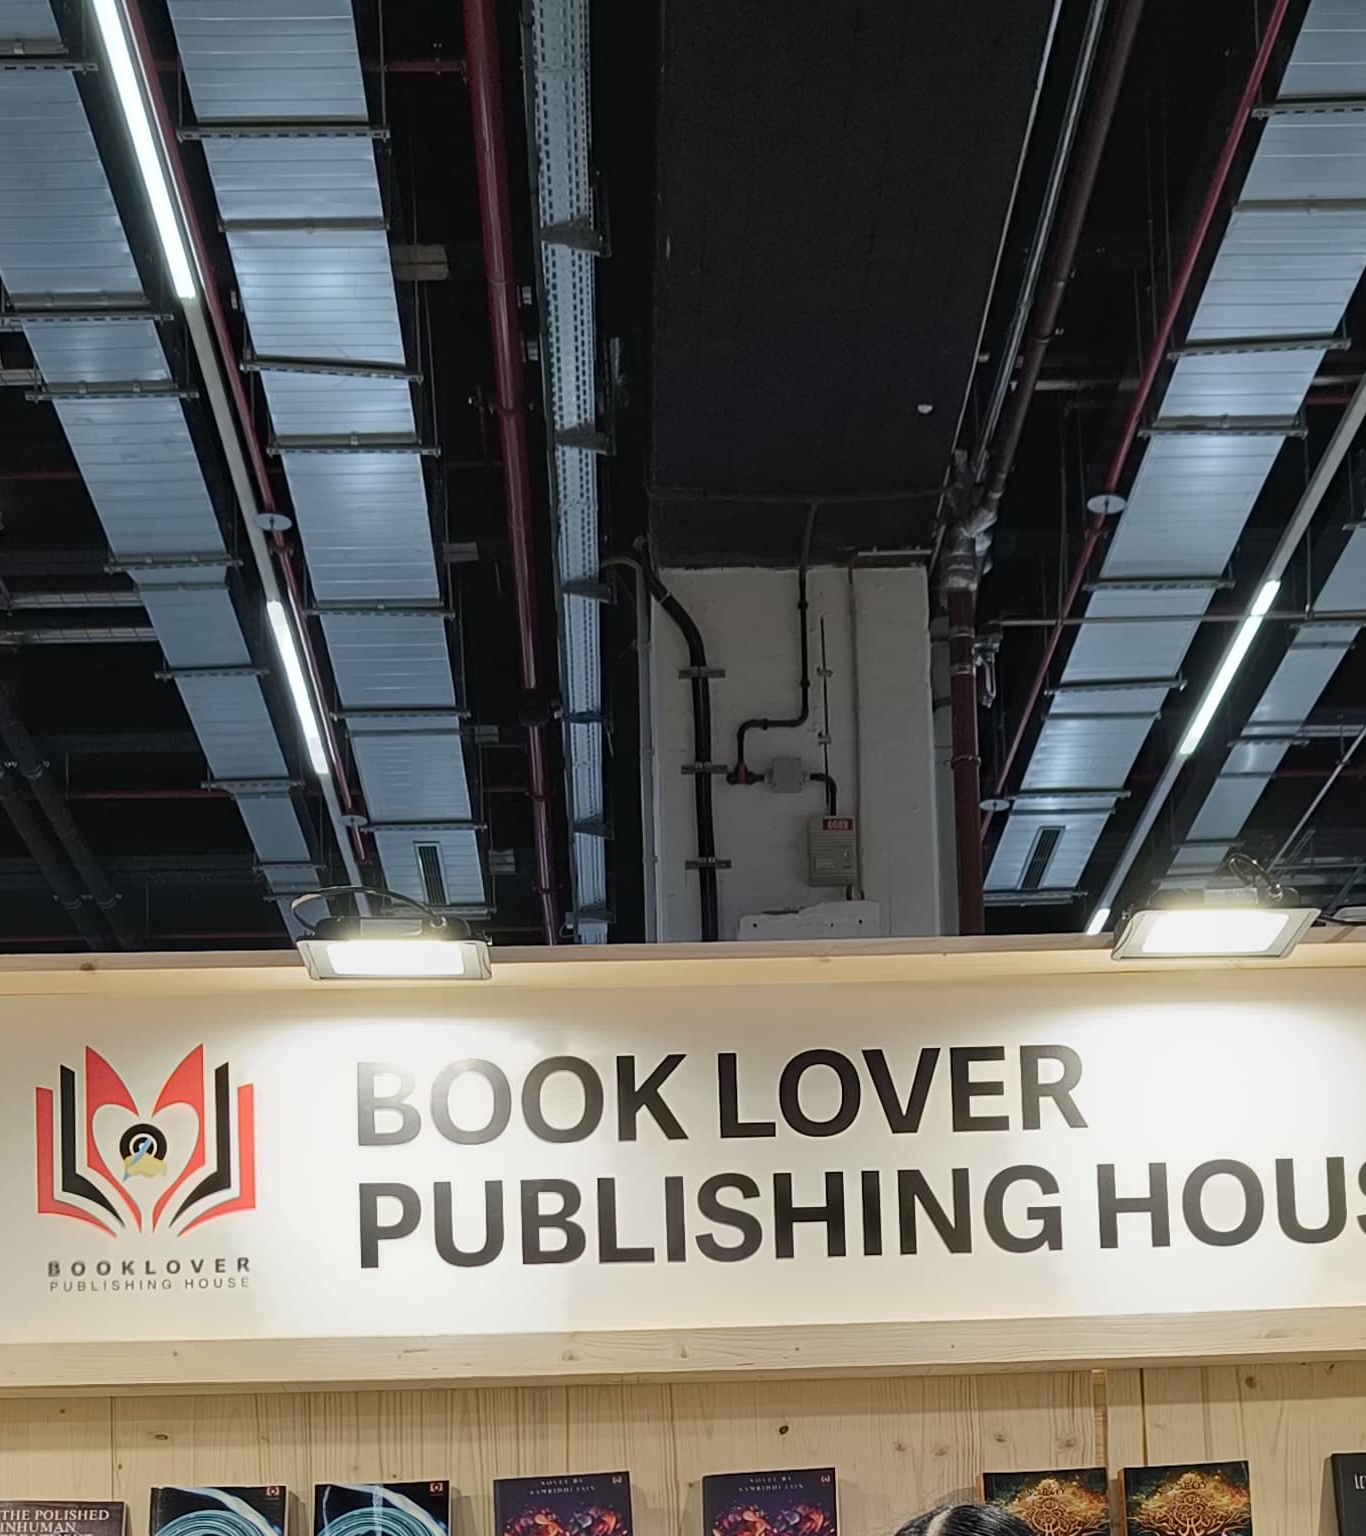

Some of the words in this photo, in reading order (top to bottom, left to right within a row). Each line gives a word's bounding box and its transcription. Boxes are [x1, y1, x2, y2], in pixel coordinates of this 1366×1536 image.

[356, 1053, 689, 1146] BOOK
[717, 1044, 1089, 1138] LOVER
[358, 1164, 1063, 1269] PUBLISHING
[49, 1278, 173, 1292] PUBLISHING
[184, 1276, 250, 1290] HOUSE
[0, 1510, 30, 1520] THE
[35, 1509, 110, 1520] POLISHED
[0, 1521, 76, 1533] INHUMAN
